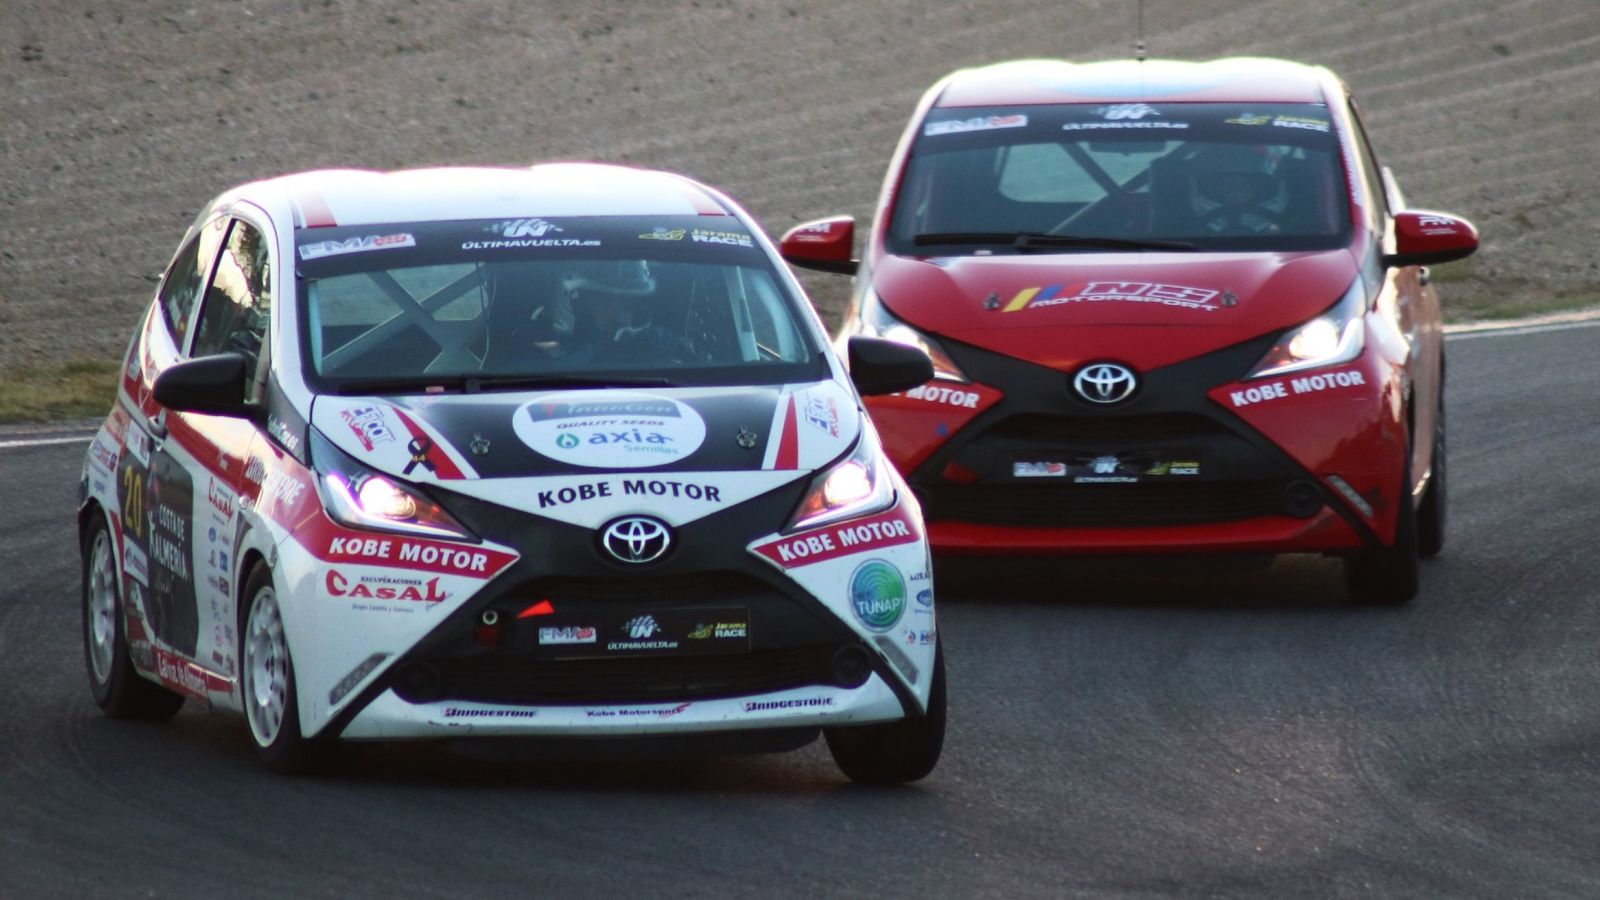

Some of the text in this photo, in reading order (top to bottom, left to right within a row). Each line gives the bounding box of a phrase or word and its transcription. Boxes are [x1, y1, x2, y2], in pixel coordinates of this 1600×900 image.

[1273, 120, 1329, 132] RACE
[692, 235, 754, 247] RACE
[1028, 295, 1219, 311] MOTORSPORT
[1230, 371, 1365, 406] KOBE MOTOR
[906, 385, 980, 408] MOTOR
[556, 418, 665, 429] QUALITY SEEDS
[588, 429, 674, 444] axia
[624, 445, 679, 455] Semillas
[538, 480, 721, 508] KOBE MOTOR
[124, 465, 142, 539] 20
[777, 519, 909, 562] KOBE MOTOR
[329, 537, 488, 571] KOBE MOTOR
[360, 576, 422, 585] RECUPERACIONES
[856, 597, 901, 615] TUNAP
[715, 622, 746, 630] Jarama
[715, 629, 746, 638] RACE
[745, 697, 833, 712] BRIDGESTONE
[444, 708, 537, 717] BRIDGESTONE
